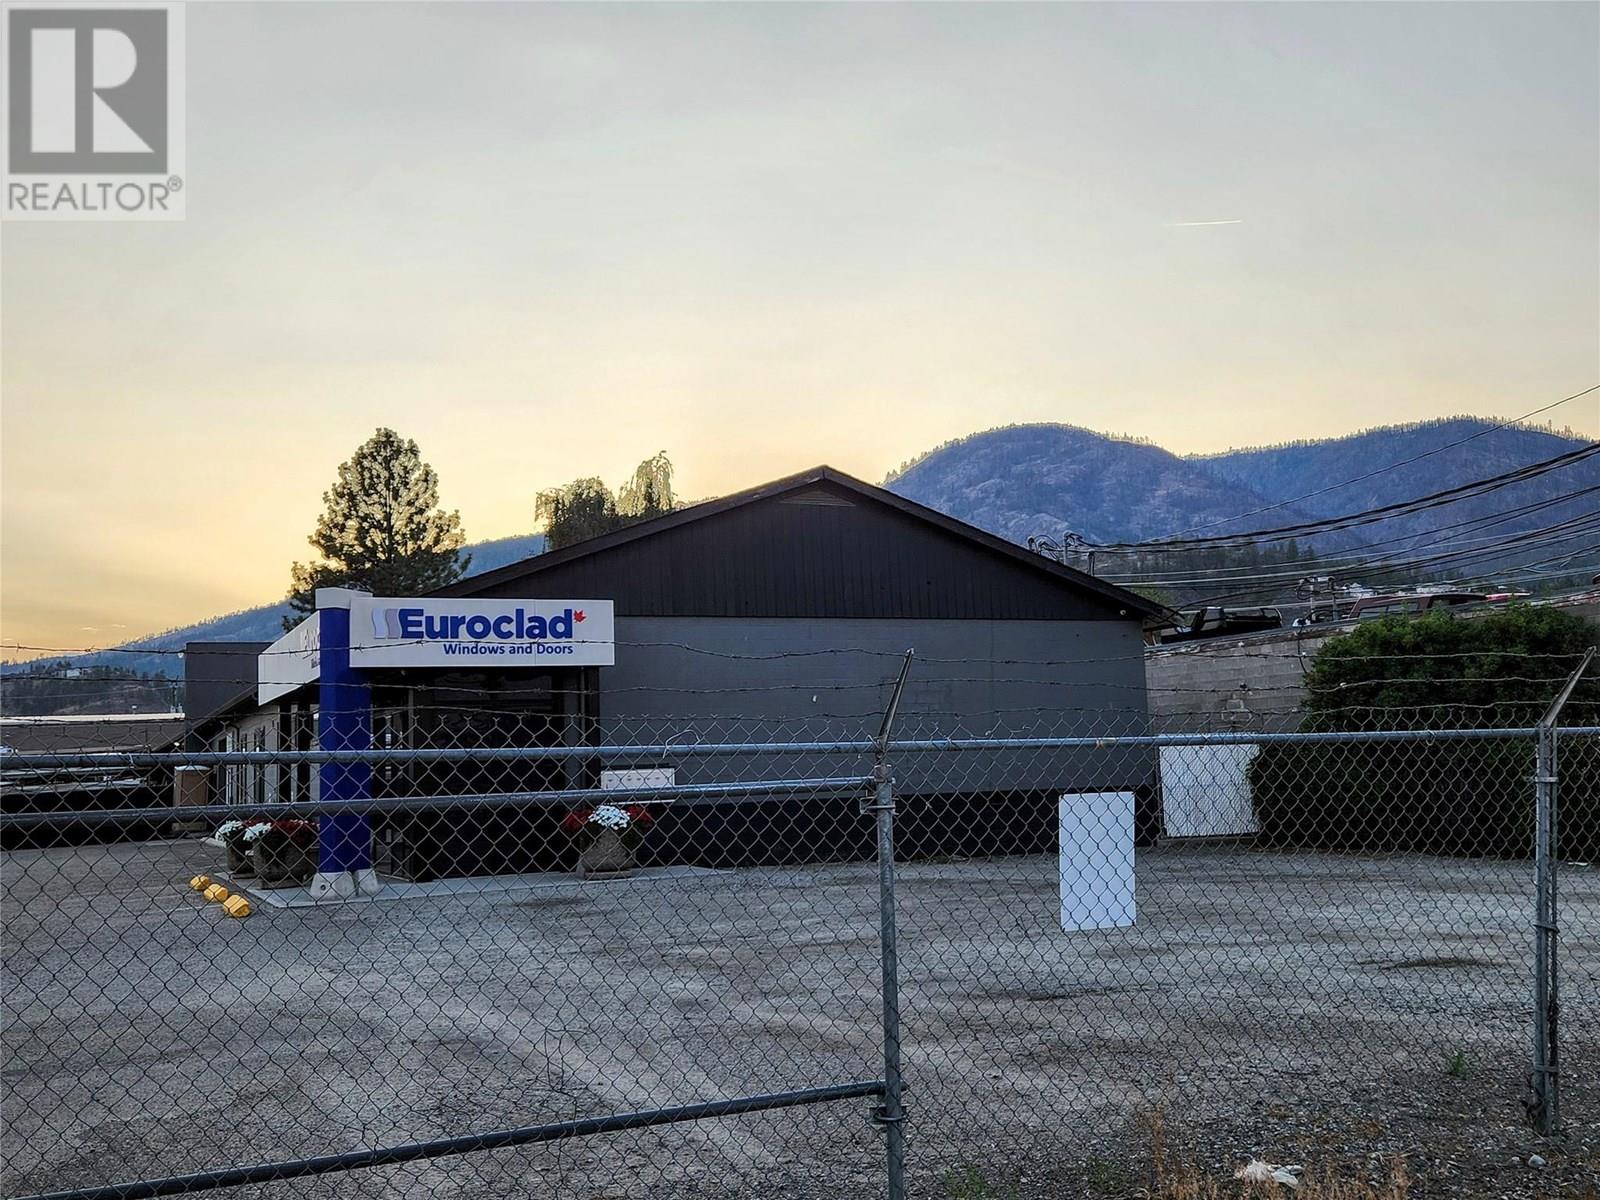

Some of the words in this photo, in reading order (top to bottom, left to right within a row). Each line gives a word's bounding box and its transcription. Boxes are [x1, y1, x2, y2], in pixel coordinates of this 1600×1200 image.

[399, 608, 573, 639] Euroclad
[443, 643, 505, 655] Windows
[509, 643, 533, 655] and
[536, 643, 574, 655] Doors
